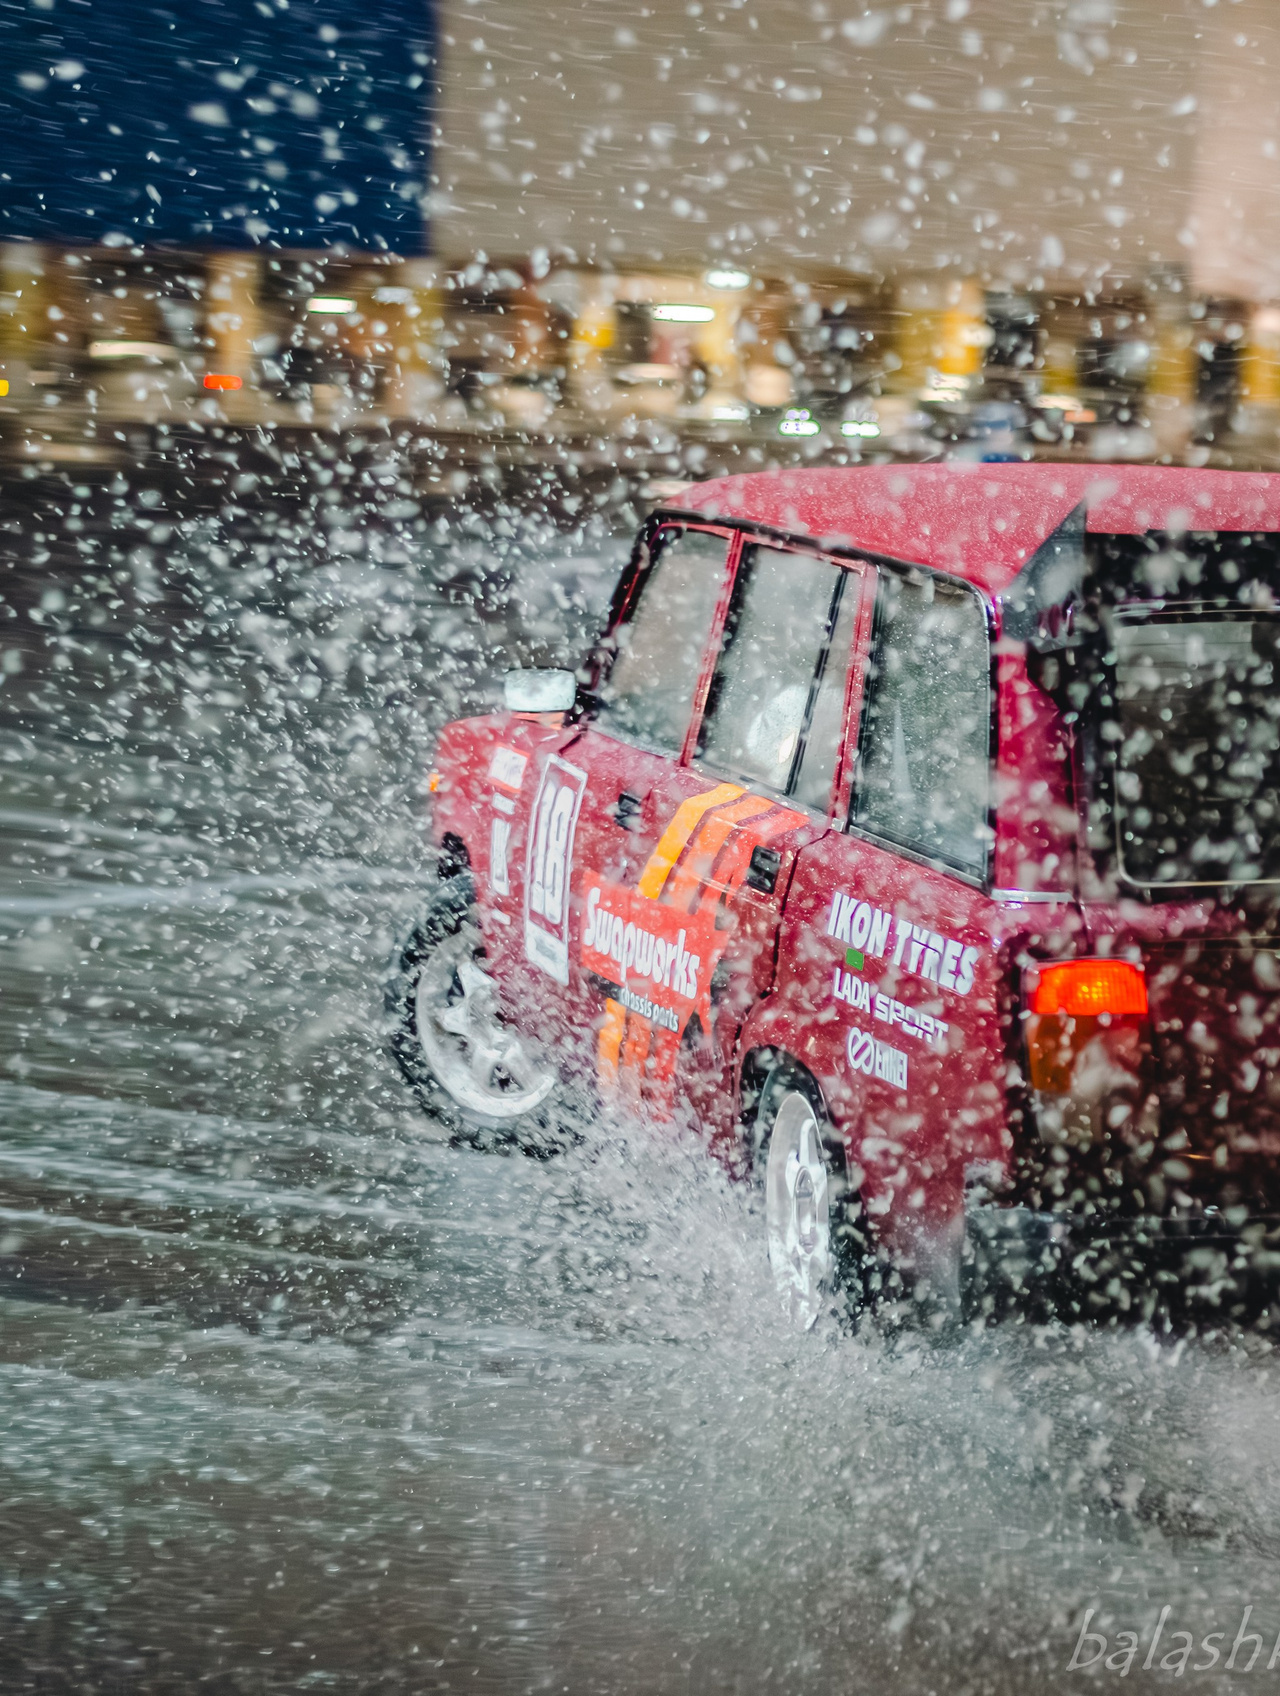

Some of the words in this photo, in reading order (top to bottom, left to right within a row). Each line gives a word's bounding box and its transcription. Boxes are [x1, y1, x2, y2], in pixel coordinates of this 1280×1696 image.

[583, 886, 700, 999] Swapworks
[827, 890, 892, 958] IKON
[892, 919, 980, 996] TYRES
[833, 967, 871, 1014] LADA
[874, 992, 949, 1044] SPORT
